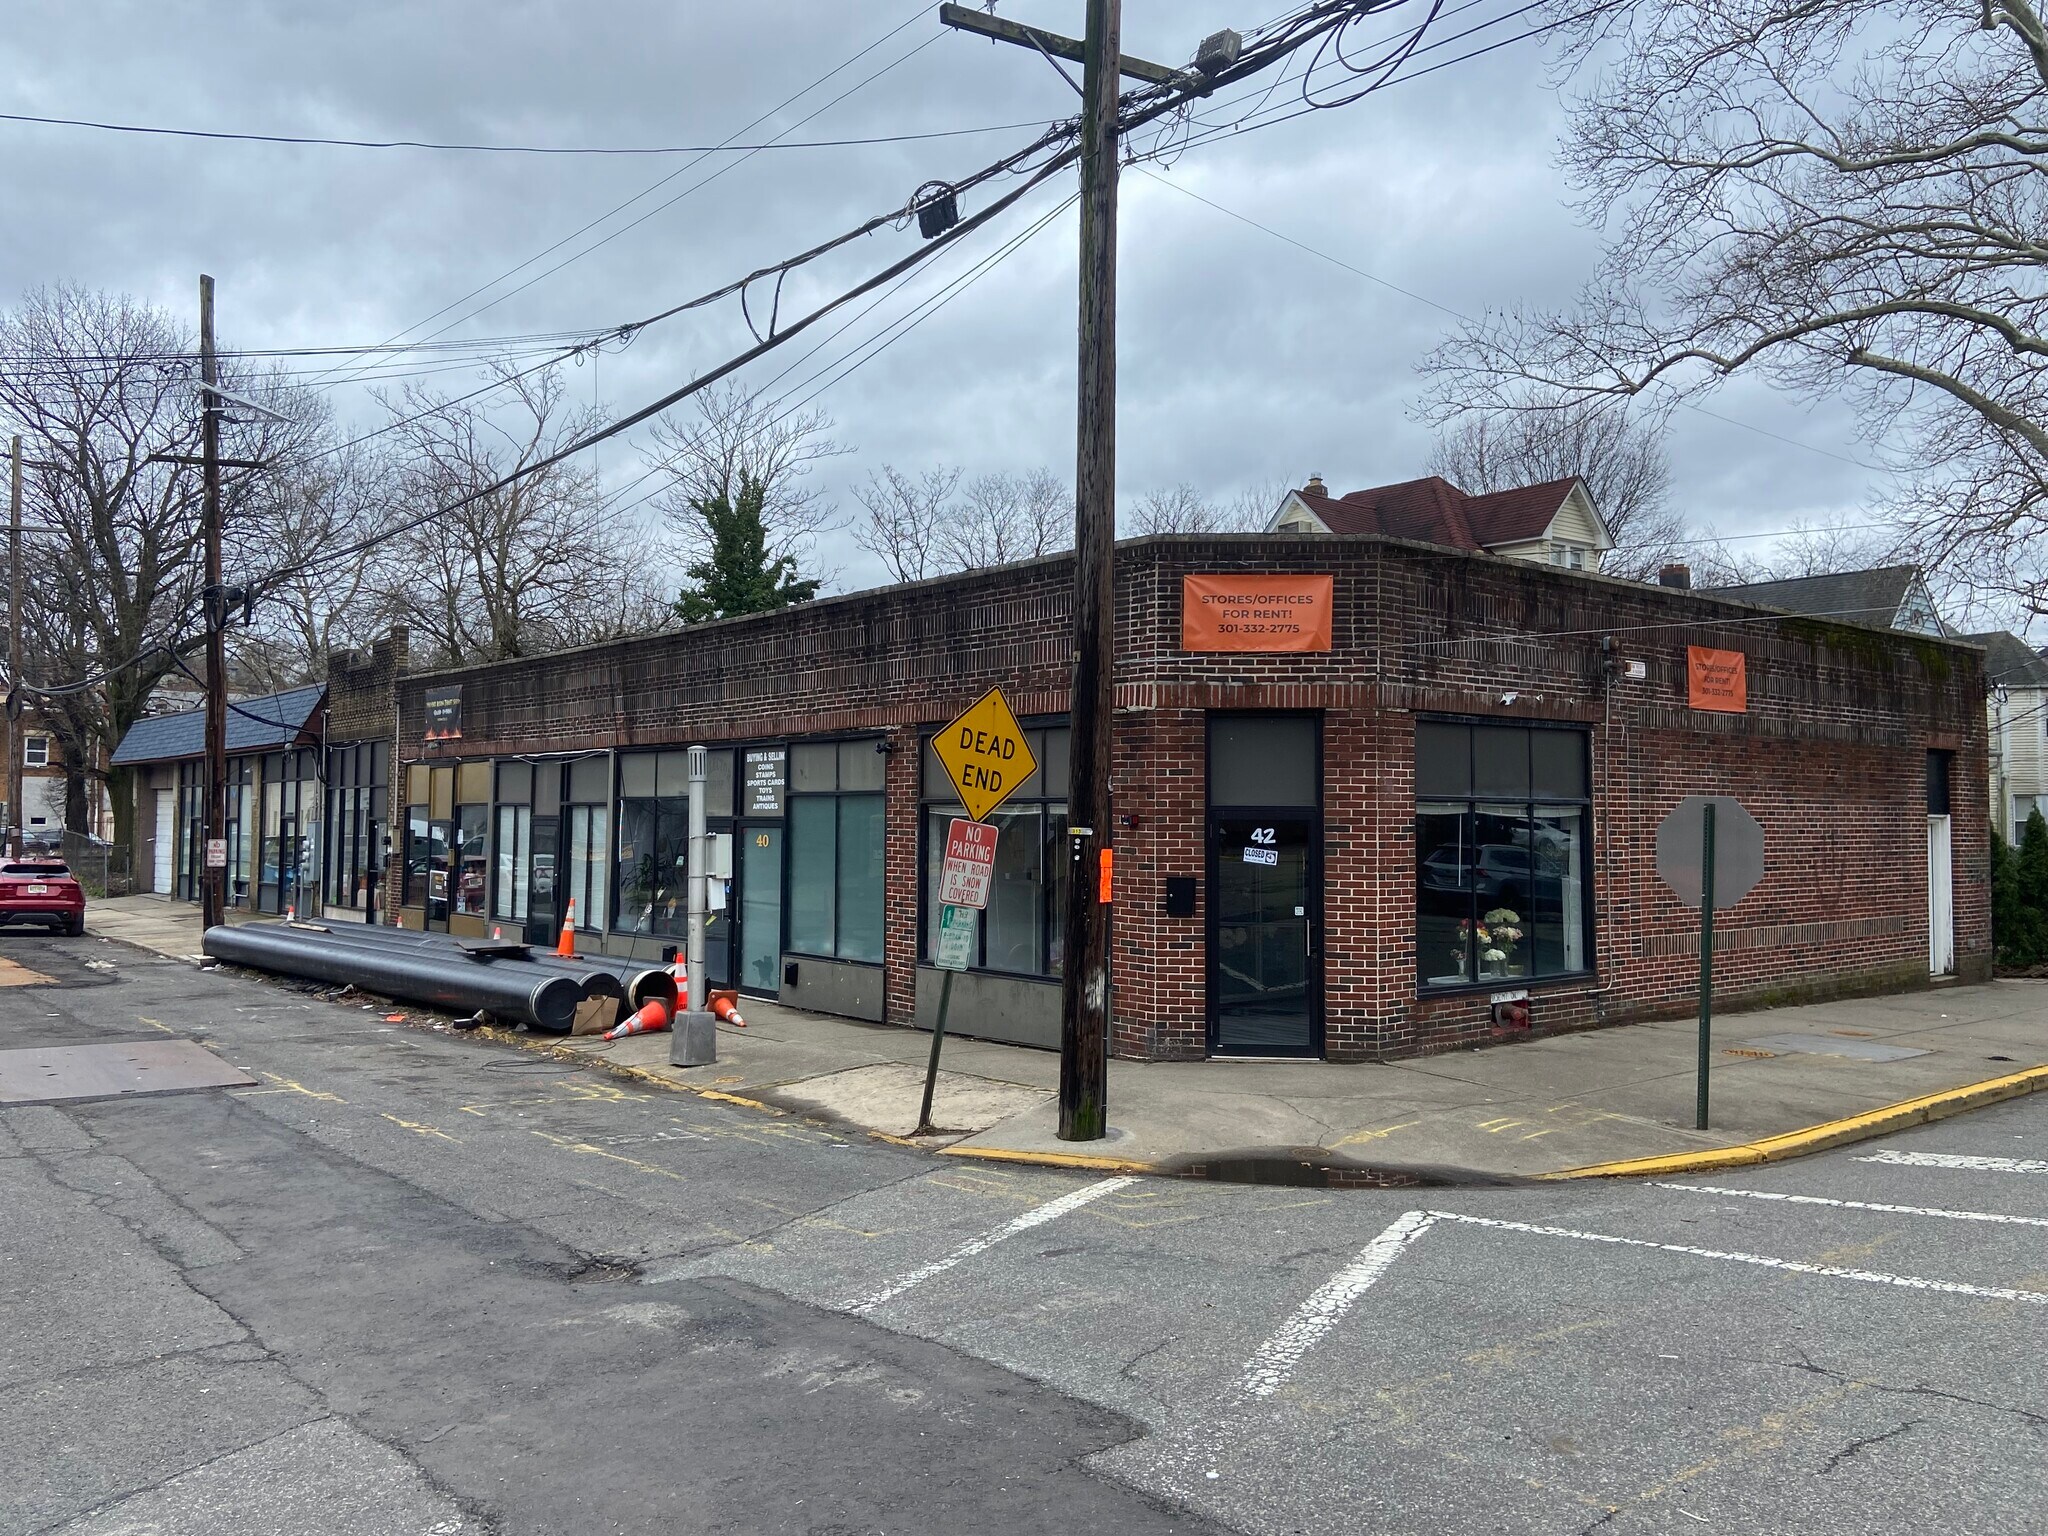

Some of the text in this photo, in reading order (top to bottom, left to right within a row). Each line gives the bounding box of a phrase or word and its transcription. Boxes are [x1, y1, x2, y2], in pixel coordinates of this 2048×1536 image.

[1202, 594, 1313, 605] STORES/OFFICES
[1222, 609, 1292, 619] FOR RENT!
[1218, 624, 1300, 633] 301-332-2775
[1695, 662, 1738, 675] STORES/OFFICES
[1704, 675, 1714, 684] FOR
[1702, 687, 1734, 697] 301-332-2775
[960, 727, 1015, 760] DEAD
[746, 752, 763, 762] BUYING
[763, 752, 768, 761] &
[757, 763, 774, 771] COINS
[755, 771, 776, 779] STAMPS
[962, 763, 1002, 792] END
[746, 778, 785, 787] SPORTS CARDS
[752, 802, 779, 810] ANTIQUES
[965, 825, 982, 843] NO
[1250, 827, 1277, 844] 42
[756, 834, 769, 847] 40
[951, 840, 991, 862] PARKING
[1244, 848, 1265, 859] CLOSED
[947, 860, 990, 878] WHEN ROAD
[950, 873, 982, 889] IS SNOW
[948, 887, 979, 903] COVERED
